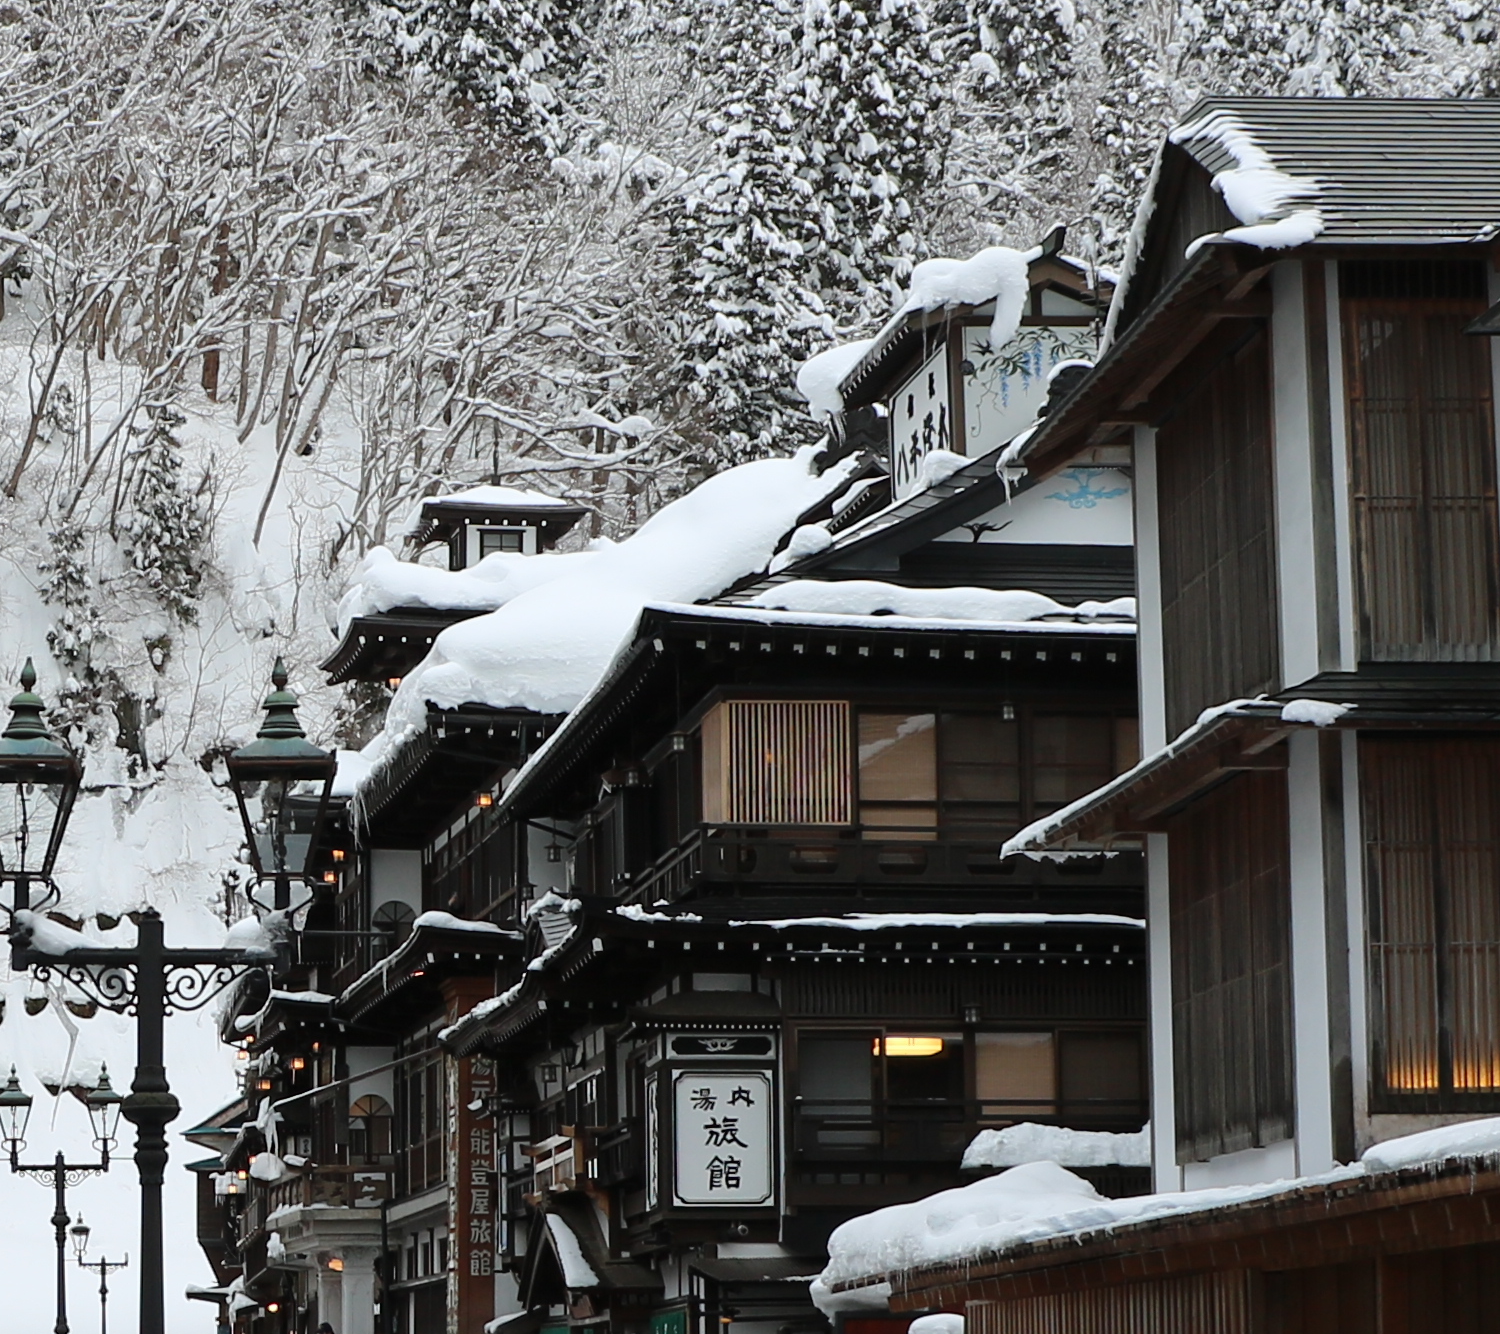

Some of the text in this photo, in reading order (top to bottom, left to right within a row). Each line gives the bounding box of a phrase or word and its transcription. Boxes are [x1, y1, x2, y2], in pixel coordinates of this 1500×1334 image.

[468, 1127, 492, 1278] 能登屋旅館
[702, 1115, 749, 1192] 旅館
